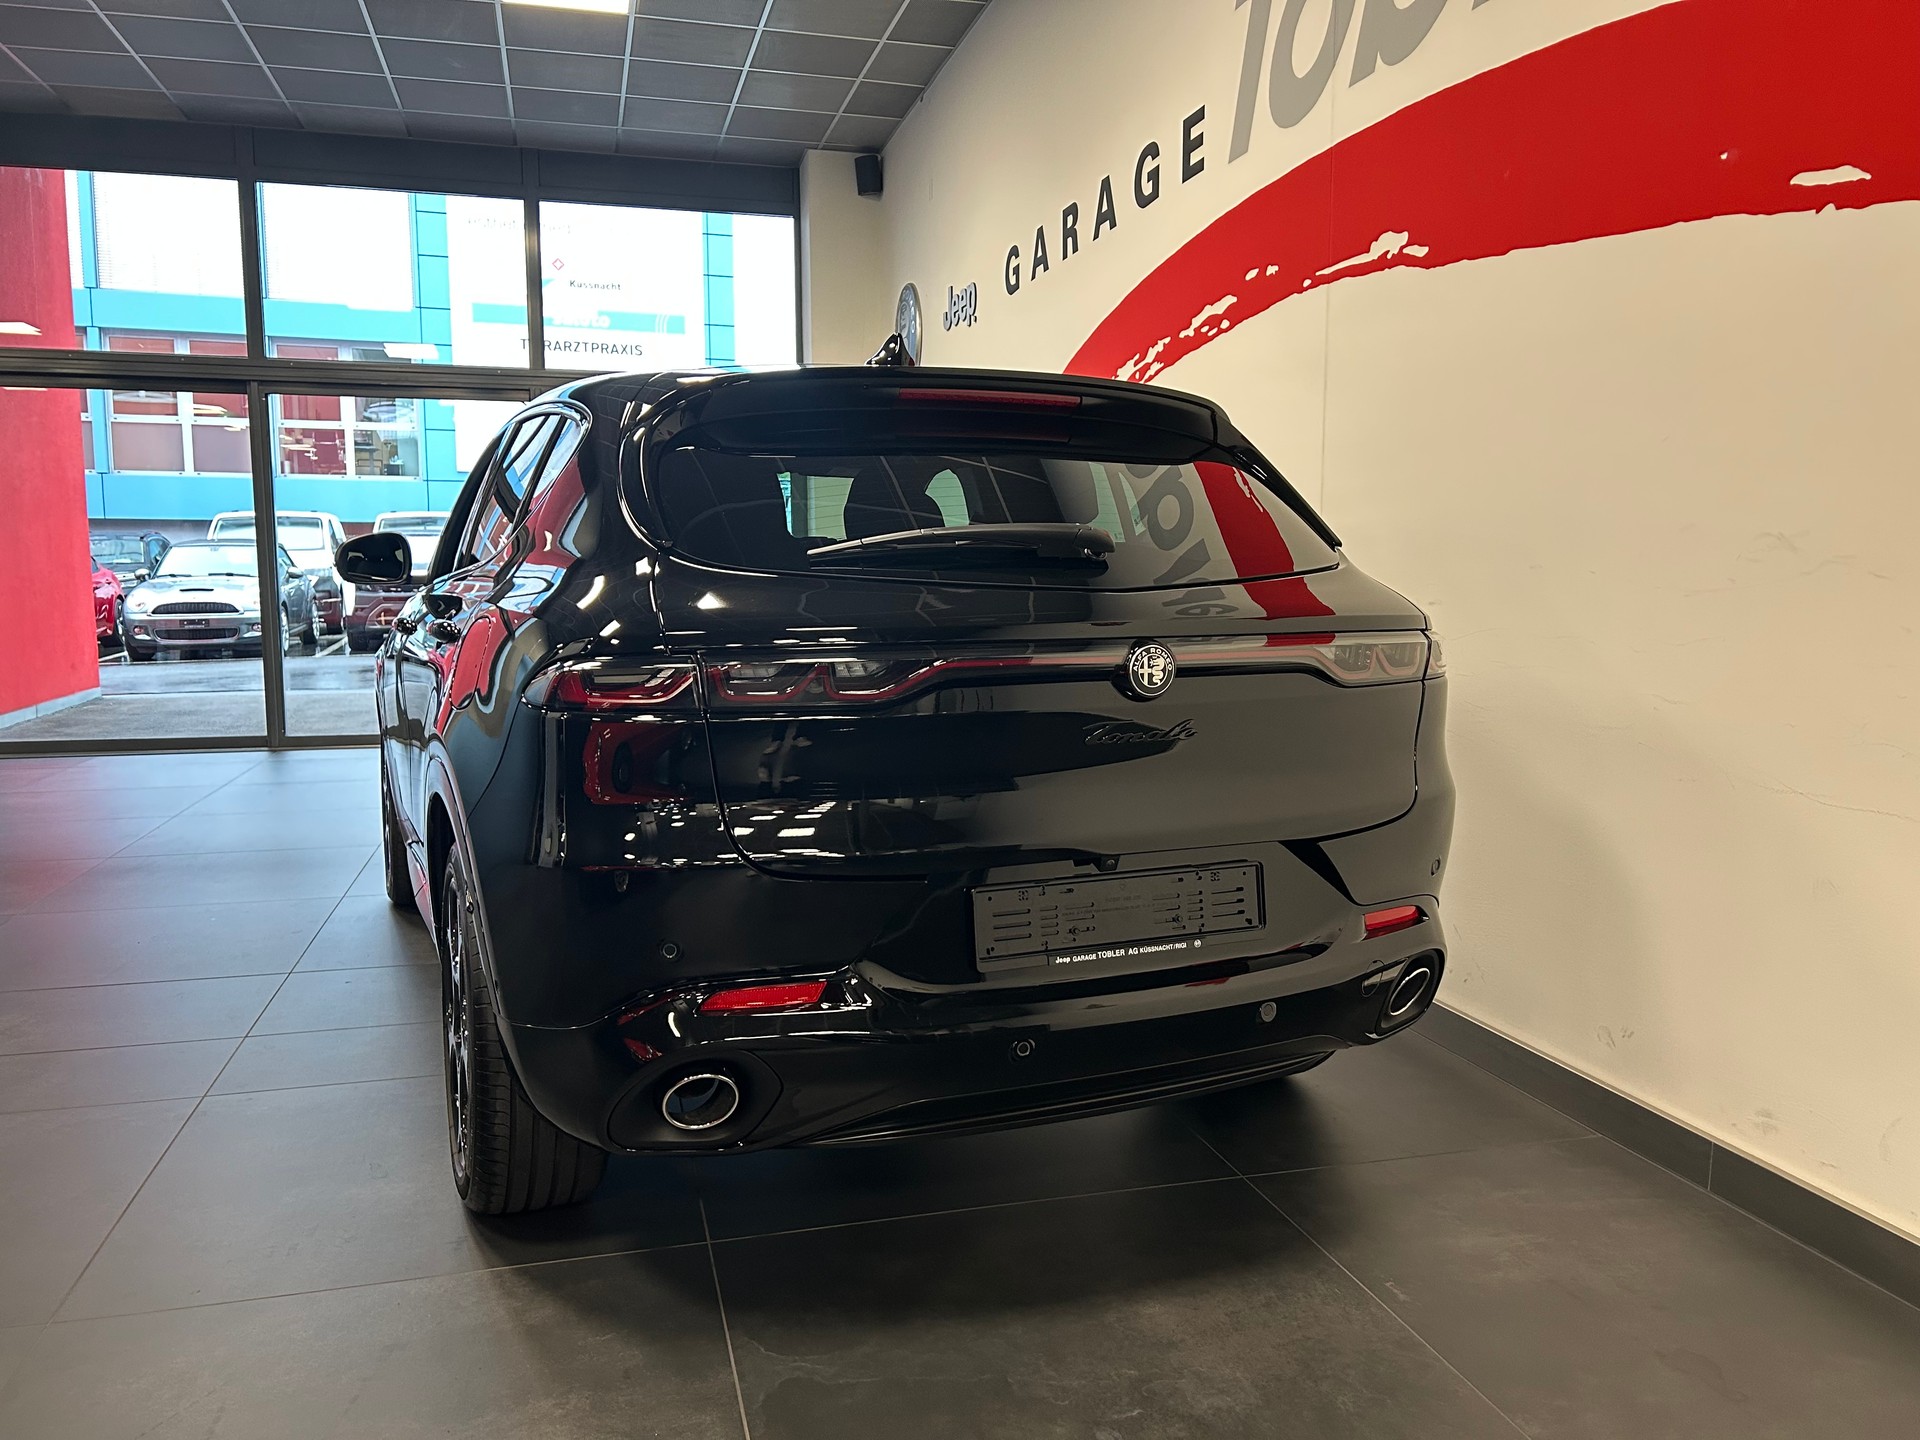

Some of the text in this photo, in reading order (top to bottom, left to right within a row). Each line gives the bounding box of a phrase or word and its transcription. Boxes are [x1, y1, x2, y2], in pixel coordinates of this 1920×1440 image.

[943, 282, 977, 331] Jeep
[1004, 103, 1206, 296] GARAGE
[520, 338, 643, 356] TRARZTPRAXIS
[1133, 647, 1173, 672] ALFA ROMEO
[1072, 953, 1097, 962] GARAGE
[1097, 948, 1126, 959] TOBLER
[1128, 947, 1139, 955] AG
